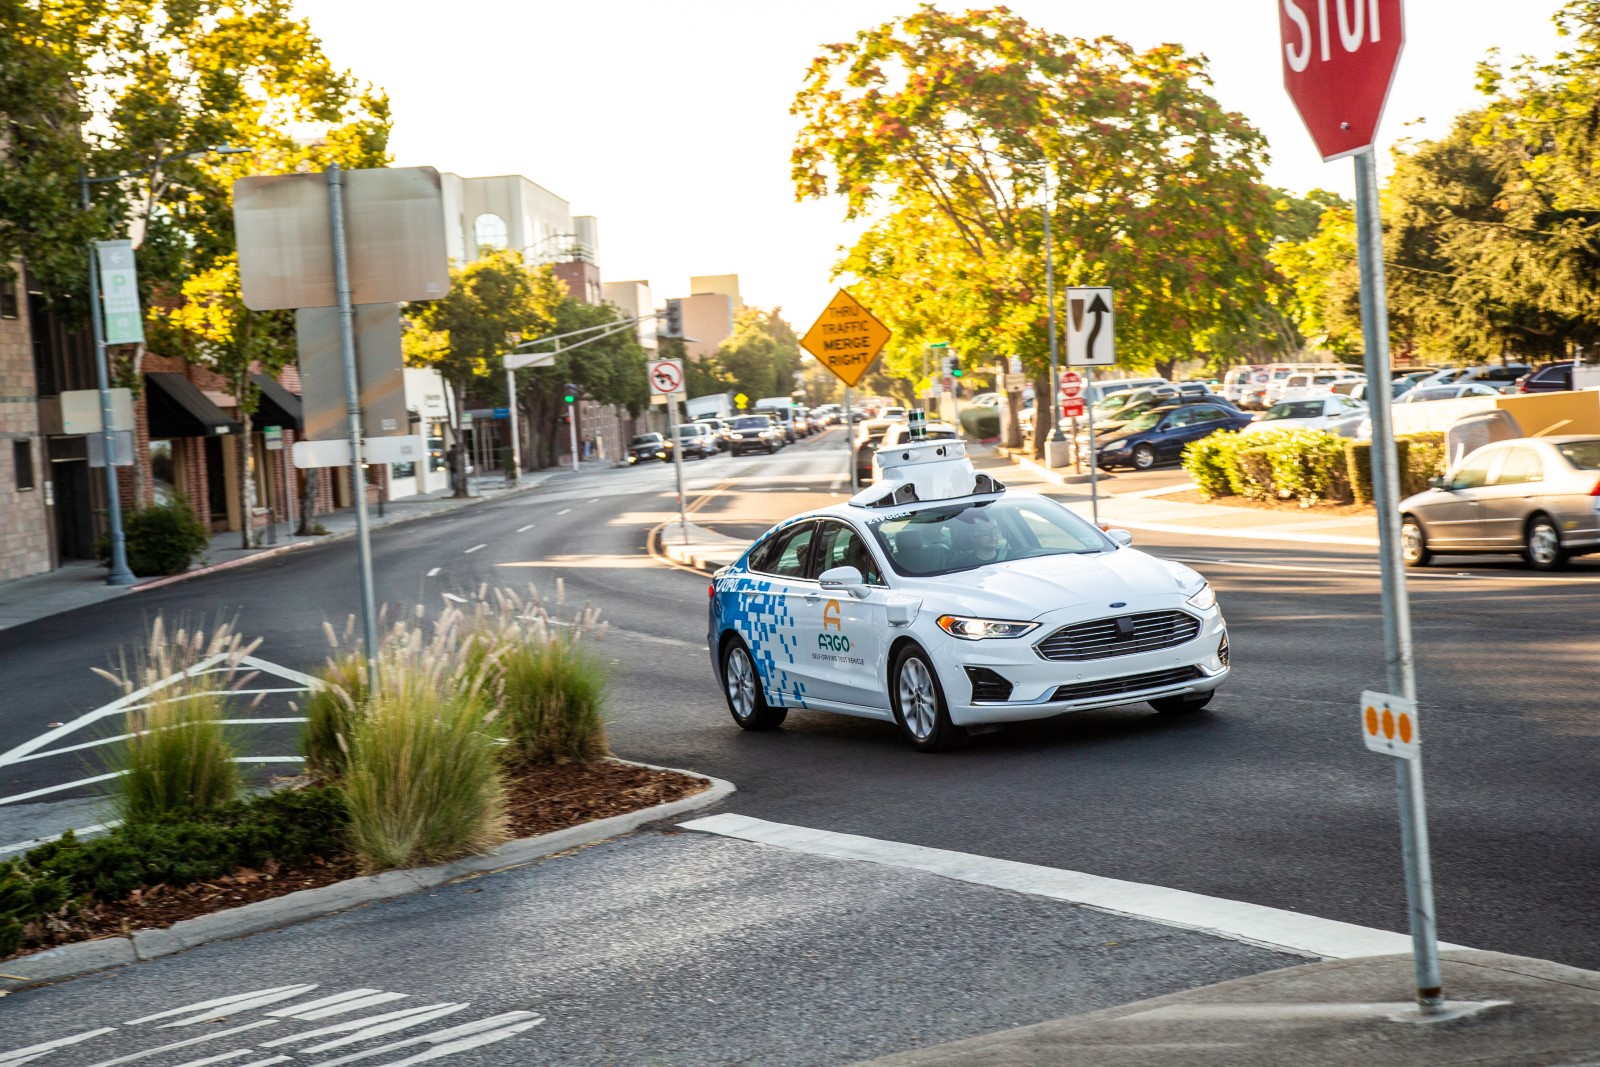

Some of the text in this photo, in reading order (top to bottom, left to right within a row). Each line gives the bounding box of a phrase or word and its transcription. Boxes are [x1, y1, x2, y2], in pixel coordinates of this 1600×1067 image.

[111, 274, 127, 292] P
[828, 306, 860, 318] THRU
[822, 320, 869, 335] TRAFFIC
[823, 336, 871, 351] MERGE
[828, 352, 869, 367] RIGHT
[818, 633, 850, 653] ARGO
[811, 652, 838, 662] SELF-DRIVING
[848, 657, 865, 666] VEHICLE
